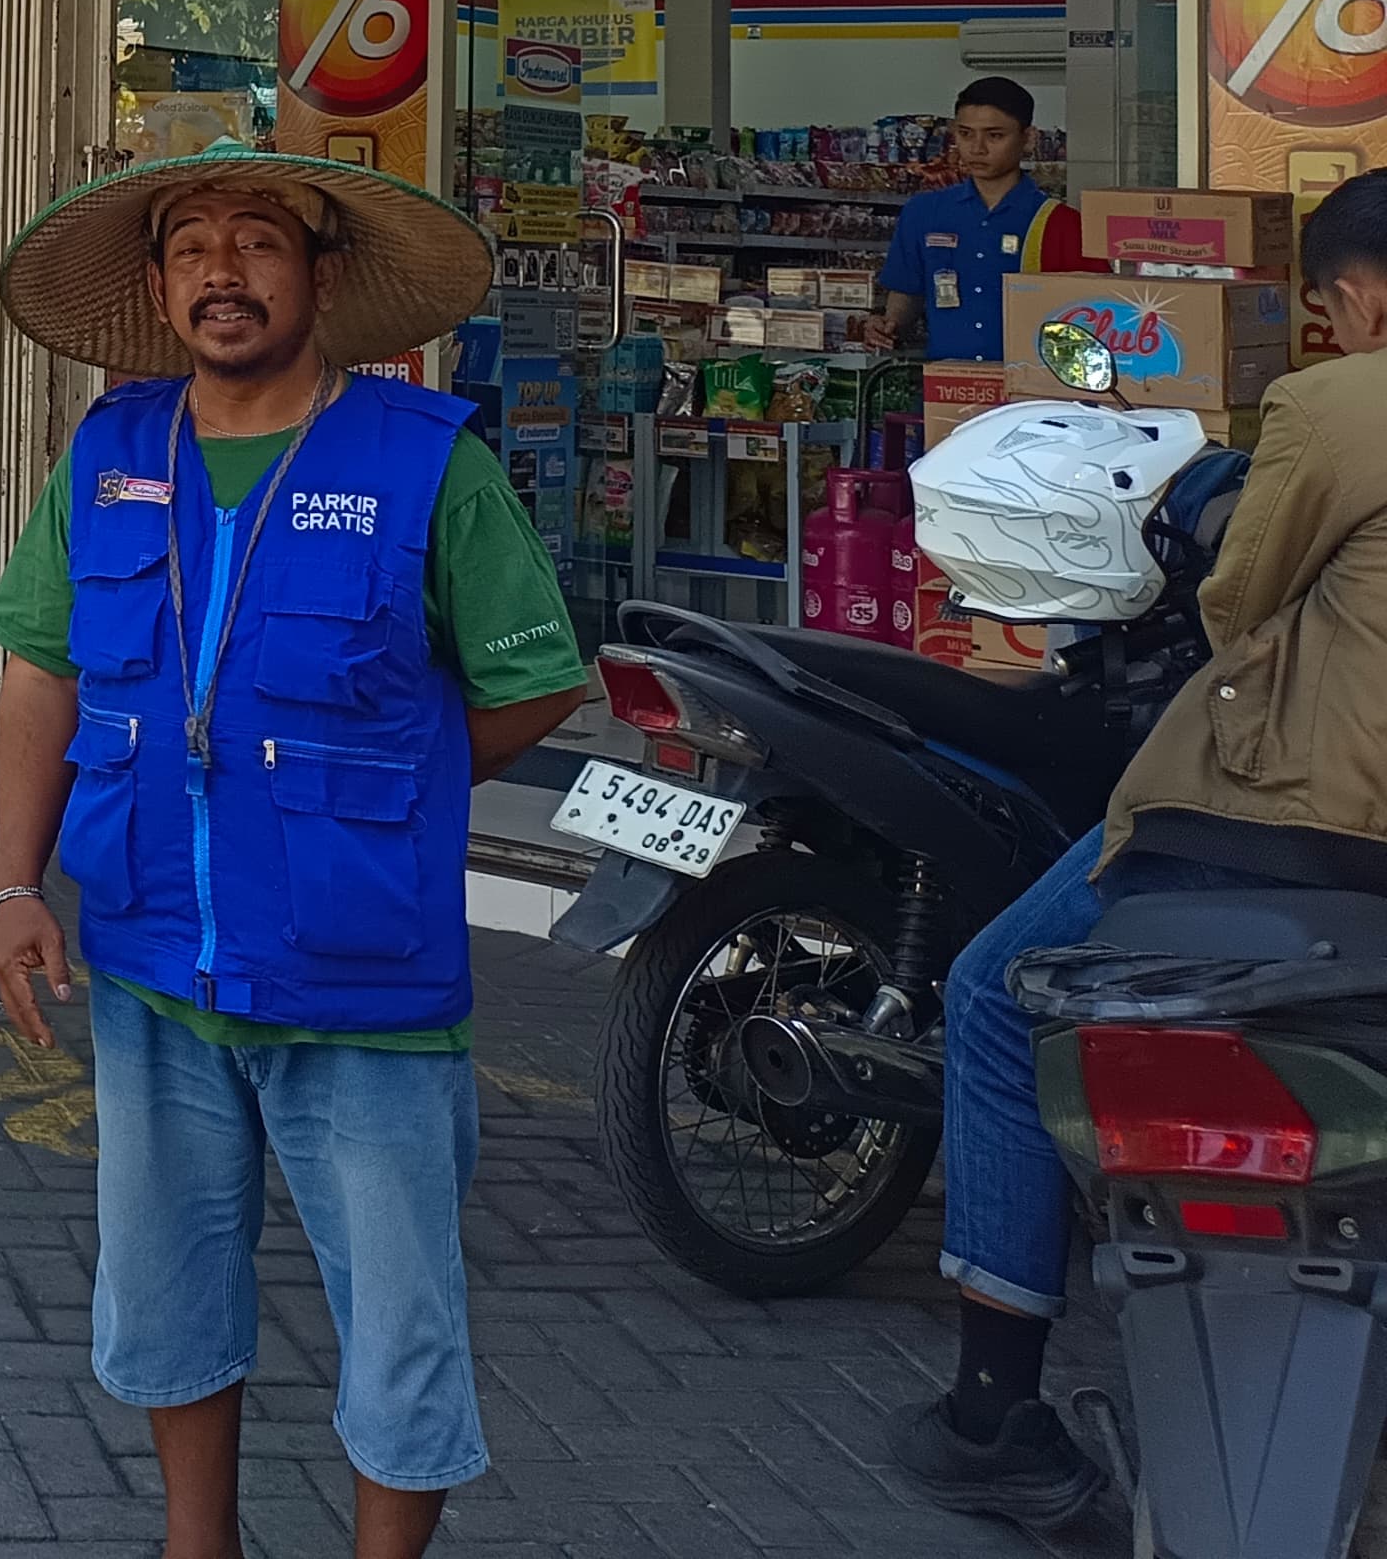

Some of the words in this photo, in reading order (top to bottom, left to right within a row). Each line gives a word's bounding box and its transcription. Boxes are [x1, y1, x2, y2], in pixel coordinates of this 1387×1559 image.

[515, 16, 569, 28] HARGA
[936, 385, 996, 402] SPESIAL
[292, 492, 378, 516] PARKIR
[292, 512, 375, 536] GRATIS
[485, 619, 561, 655] VALENTINO
[576, 767, 594, 795] L
[601, 773, 679, 820] 5494
[678, 799, 734, 837] DAS
